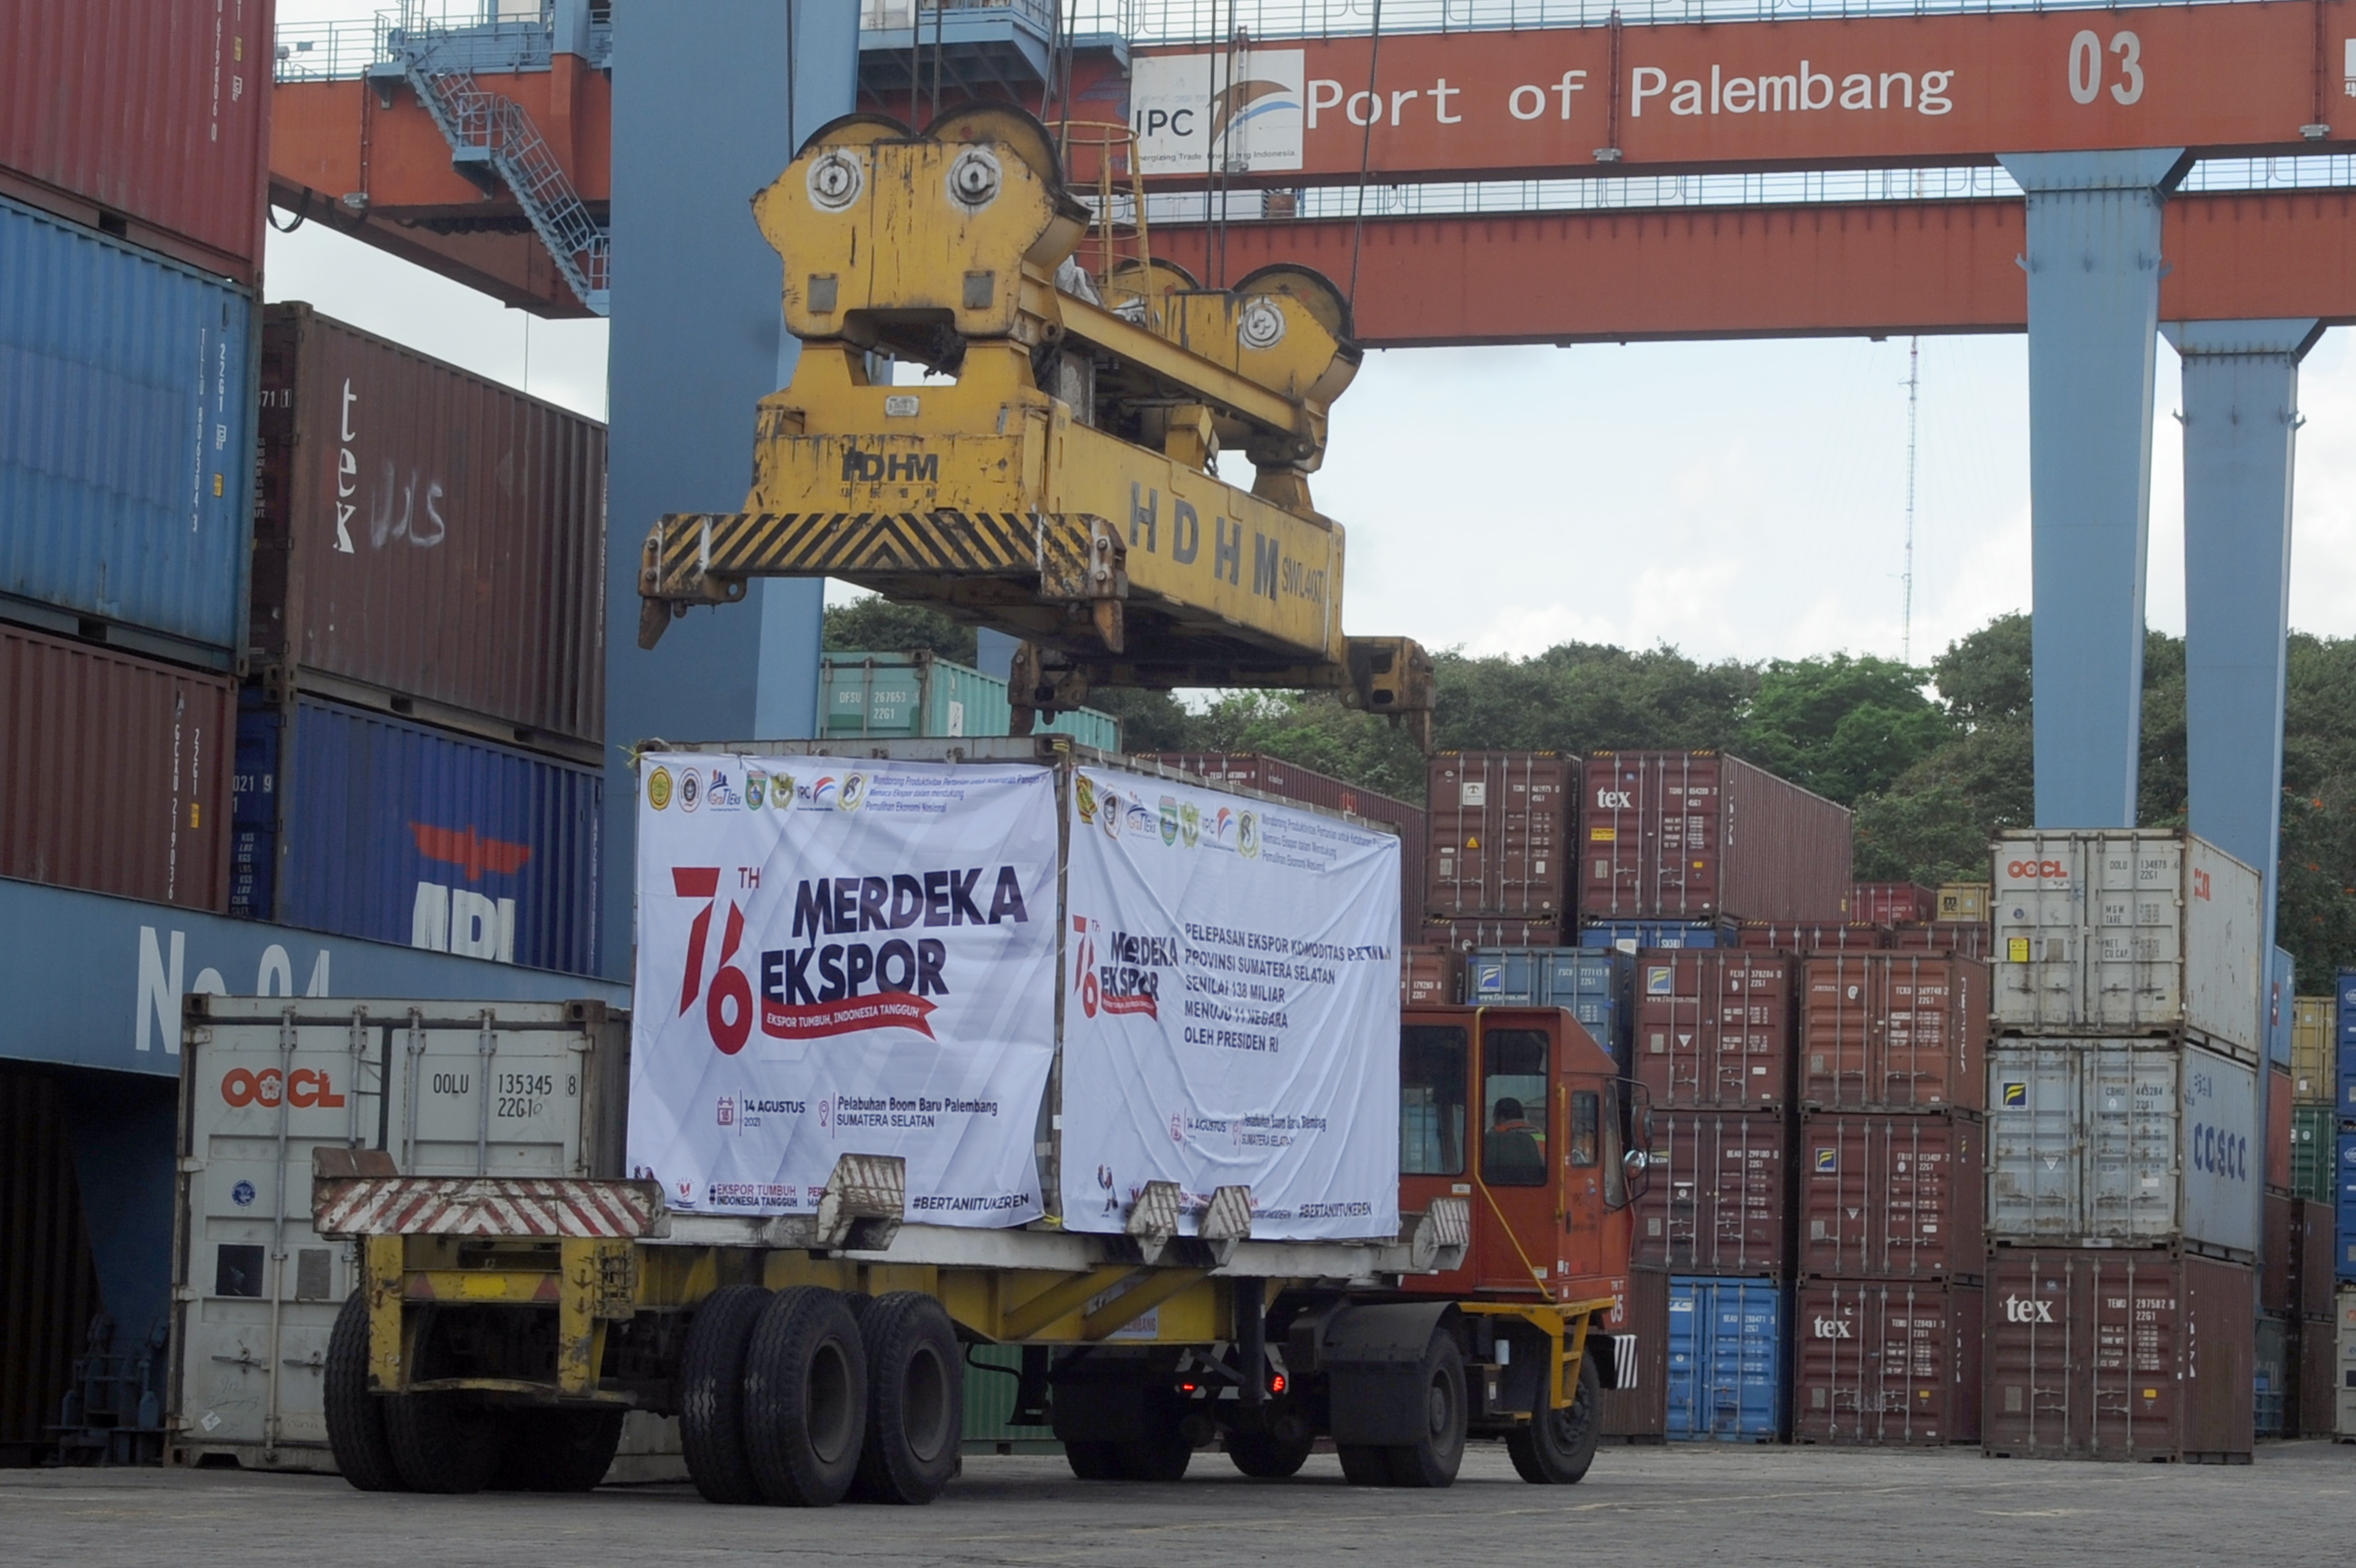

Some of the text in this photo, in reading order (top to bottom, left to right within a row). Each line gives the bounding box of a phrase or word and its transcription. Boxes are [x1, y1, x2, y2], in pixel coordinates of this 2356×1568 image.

[2069, 29, 2144, 105] 03
[1308, 60, 1954, 129] Port of Palembang
[1137, 108, 1194, 137] IPC
[191, 514, 198, 532] 3
[1129, 481, 1279, 601] HDHM
[839, 692, 862, 703] DFSU
[874, 691, 906, 703] 267653
[797, 786, 811, 799] IPC
[1596, 786, 1632, 809] tex
[1712, 786, 1718, 796] 7
[922, 802, 947, 813] Nasional
[2140, 859, 2168, 869] 134878
[2173, 860, 2179, 869] 6
[737, 867, 760, 889] TH
[792, 865, 1030, 948] MERDEKA
[2106, 915, 2122, 924] TARE
[1185, 922, 1245, 948] PELEPASAN
[1248, 932, 1289, 954] EKSPOR
[1290, 940, 1345, 962] KOMODITAS
[761, 938, 950, 1005] EKSPOR
[1185, 948, 1335, 985] PROVINSI SUMATERA SELATAN
[1186, 974, 1229, 995] SENILAI
[1249, 984, 1285, 1003] MILIAR
[1918, 987, 1942, 995] 369748
[1943, 986, 1950, 996] 2
[767, 1012, 797, 1027] EKSPOR
[834, 1007, 879, 1024] INDONESIA
[881, 1004, 919, 1018] TANGGUH
[1184, 1000, 1232, 1021] MENUJU
[1247, 1008, 1288, 1028] NEGARA
[1184, 1026, 1279, 1053] OLEH PRESIDEN RI
[498, 1074, 552, 1095] 135345
[568, 1076, 577, 1096] 8
[498, 1097, 534, 1118] 22G1
[743, 1100, 806, 1114] 14 AGUSTUS
[838, 1096, 998, 1116] Pelabuhan Boom Baru Palembang
[743, 1117, 761, 1127] 2021
[836, 1114, 935, 1128] SUMATERA SELATAN
[1194, 1119, 1227, 1133] AGUSTUS
[757, 1185, 796, 1197] TUMBUH
[761, 1196, 798, 1208] TANGGUH
[2006, 1292, 2054, 1323] tex
[2136, 1299, 2166, 1309] 297582
[1814, 1315, 1852, 1338] tex
[2136, 1311, 2156, 1321] 22G1
